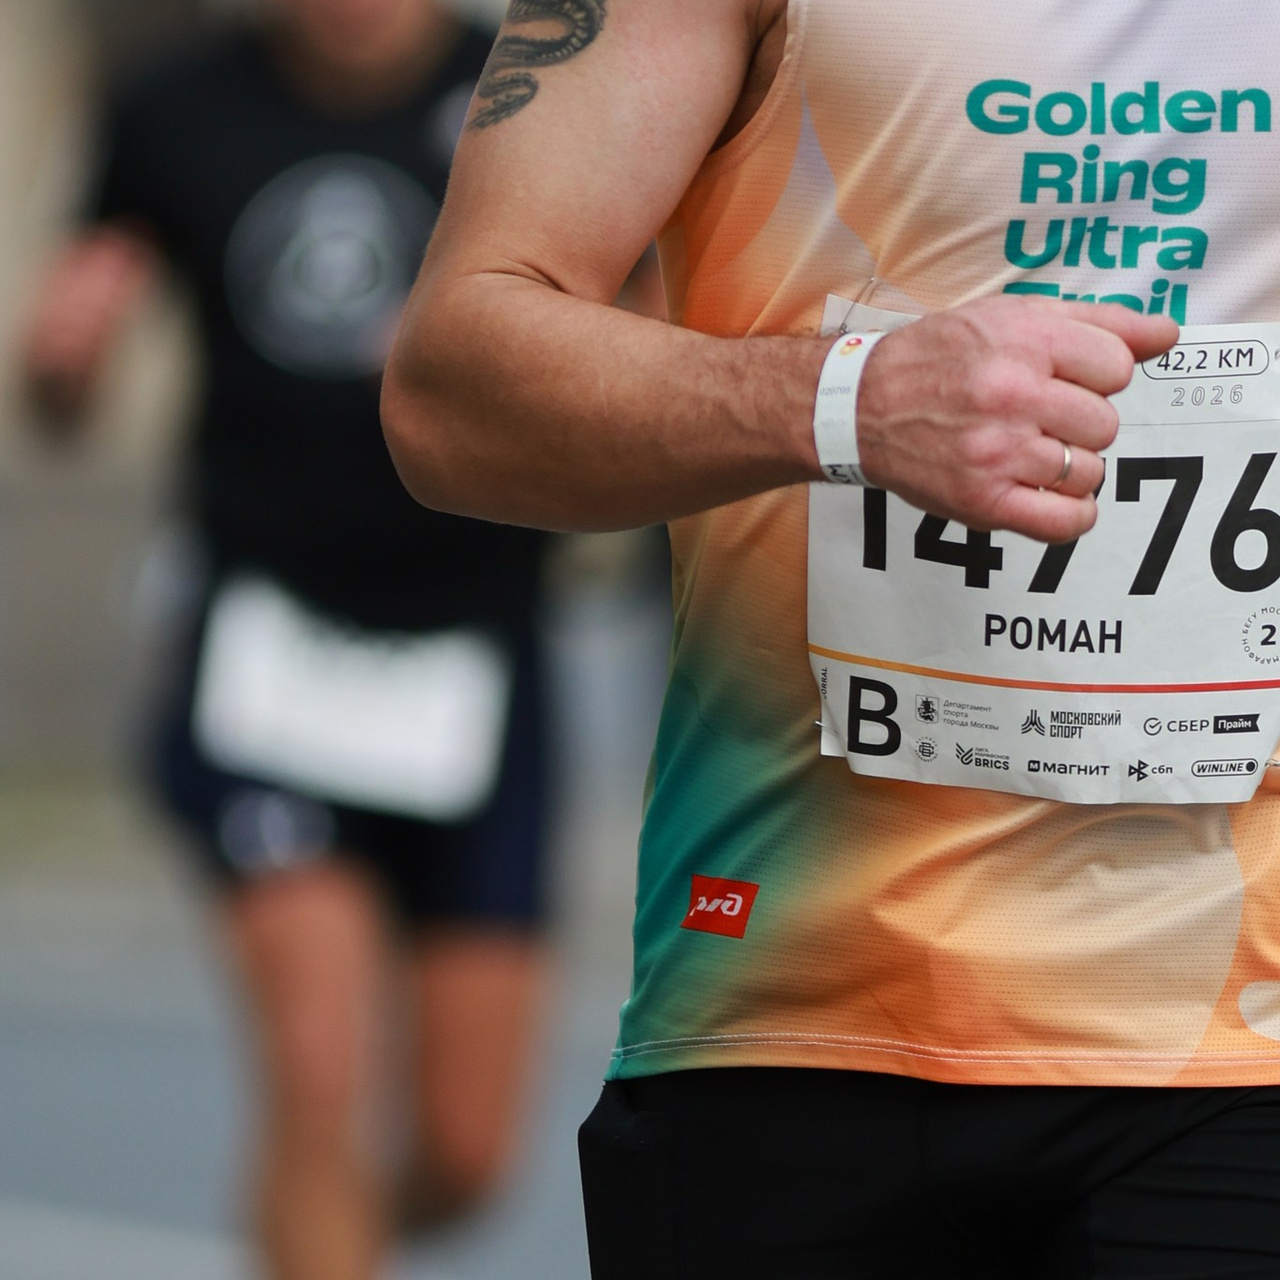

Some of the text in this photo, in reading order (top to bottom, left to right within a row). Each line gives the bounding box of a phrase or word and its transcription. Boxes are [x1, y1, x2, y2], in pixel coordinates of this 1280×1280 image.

[965, 78, 1272, 136] Golden
[1020, 145, 1207, 215] Ring
[1003, 216, 1209, 271] Ultra
[1156, 350, 1208, 374] 42,2
[1170, 384, 1243, 407] 2026
[984, 613, 1123, 654] РОМАН
[1260, 624, 1277, 646] 2
[1242, 638, 1280, 664] МАРАФОН
[847, 675, 902, 757] B
[943, 700, 992, 713] Департамент
[943, 709, 969, 718] спорта
[943, 718, 999, 731] города Москвы
[1050, 709, 1121, 726] МОСКОВСКИЙ
[1167, 718, 1252, 732] СБЕР Прайм
[1050, 725, 1083, 739] СПОРТ
[974, 757, 1010, 771] BRICS
[1151, 764, 1173, 775] сбп
[1196, 762, 1244, 774] WINLINE
